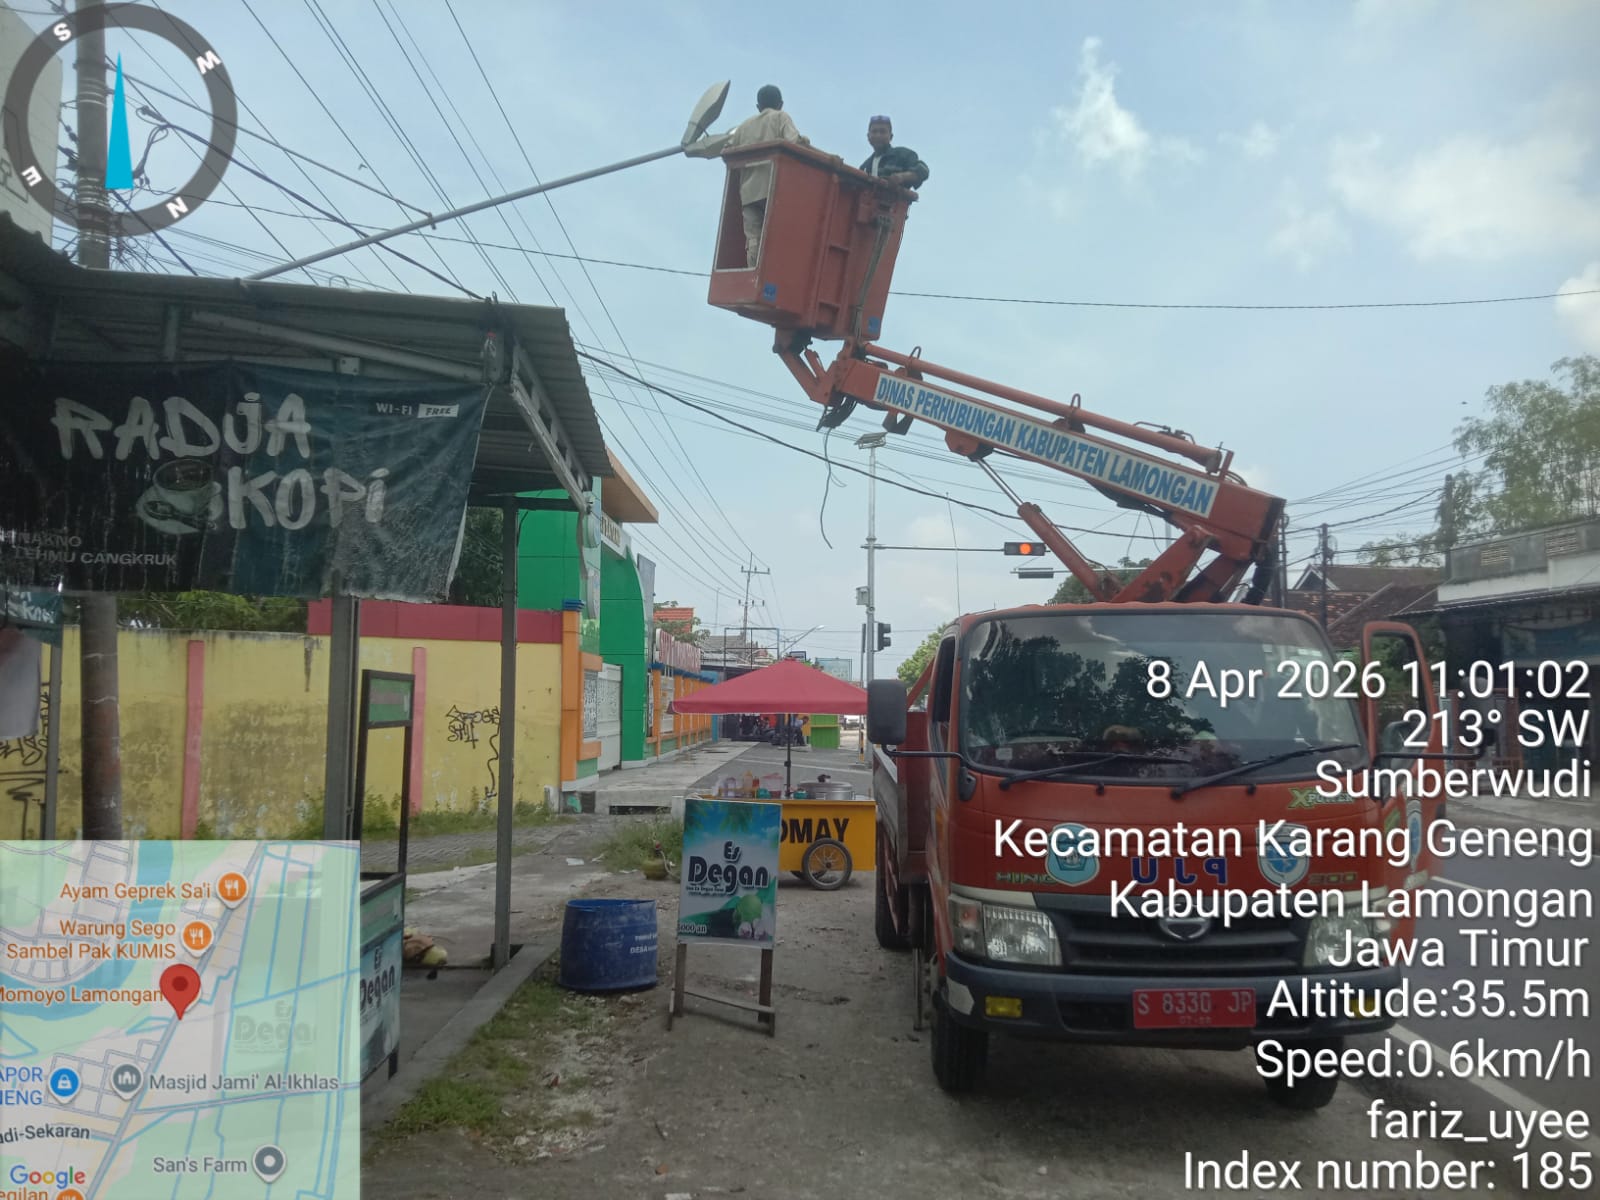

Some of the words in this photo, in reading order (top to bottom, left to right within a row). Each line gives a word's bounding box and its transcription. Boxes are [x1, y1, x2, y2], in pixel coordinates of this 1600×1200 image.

[426, 407, 451, 417] FREE
[876, 377, 915, 410] DINAS
[915, 388, 1015, 445] PERHUBUNGAN
[1016, 424, 1107, 478] KABUPATEN
[1109, 455, 1214, 514] LAMONGAN
[80, 552, 177, 566] CANGKRUK
[724, 841, 741, 860] Es
[688, 856, 769, 893] Degan
[1137, 993, 1150, 1015] S
[1162, 992, 1212, 1014] 8330
[1228, 991, 1252, 1013] JP
